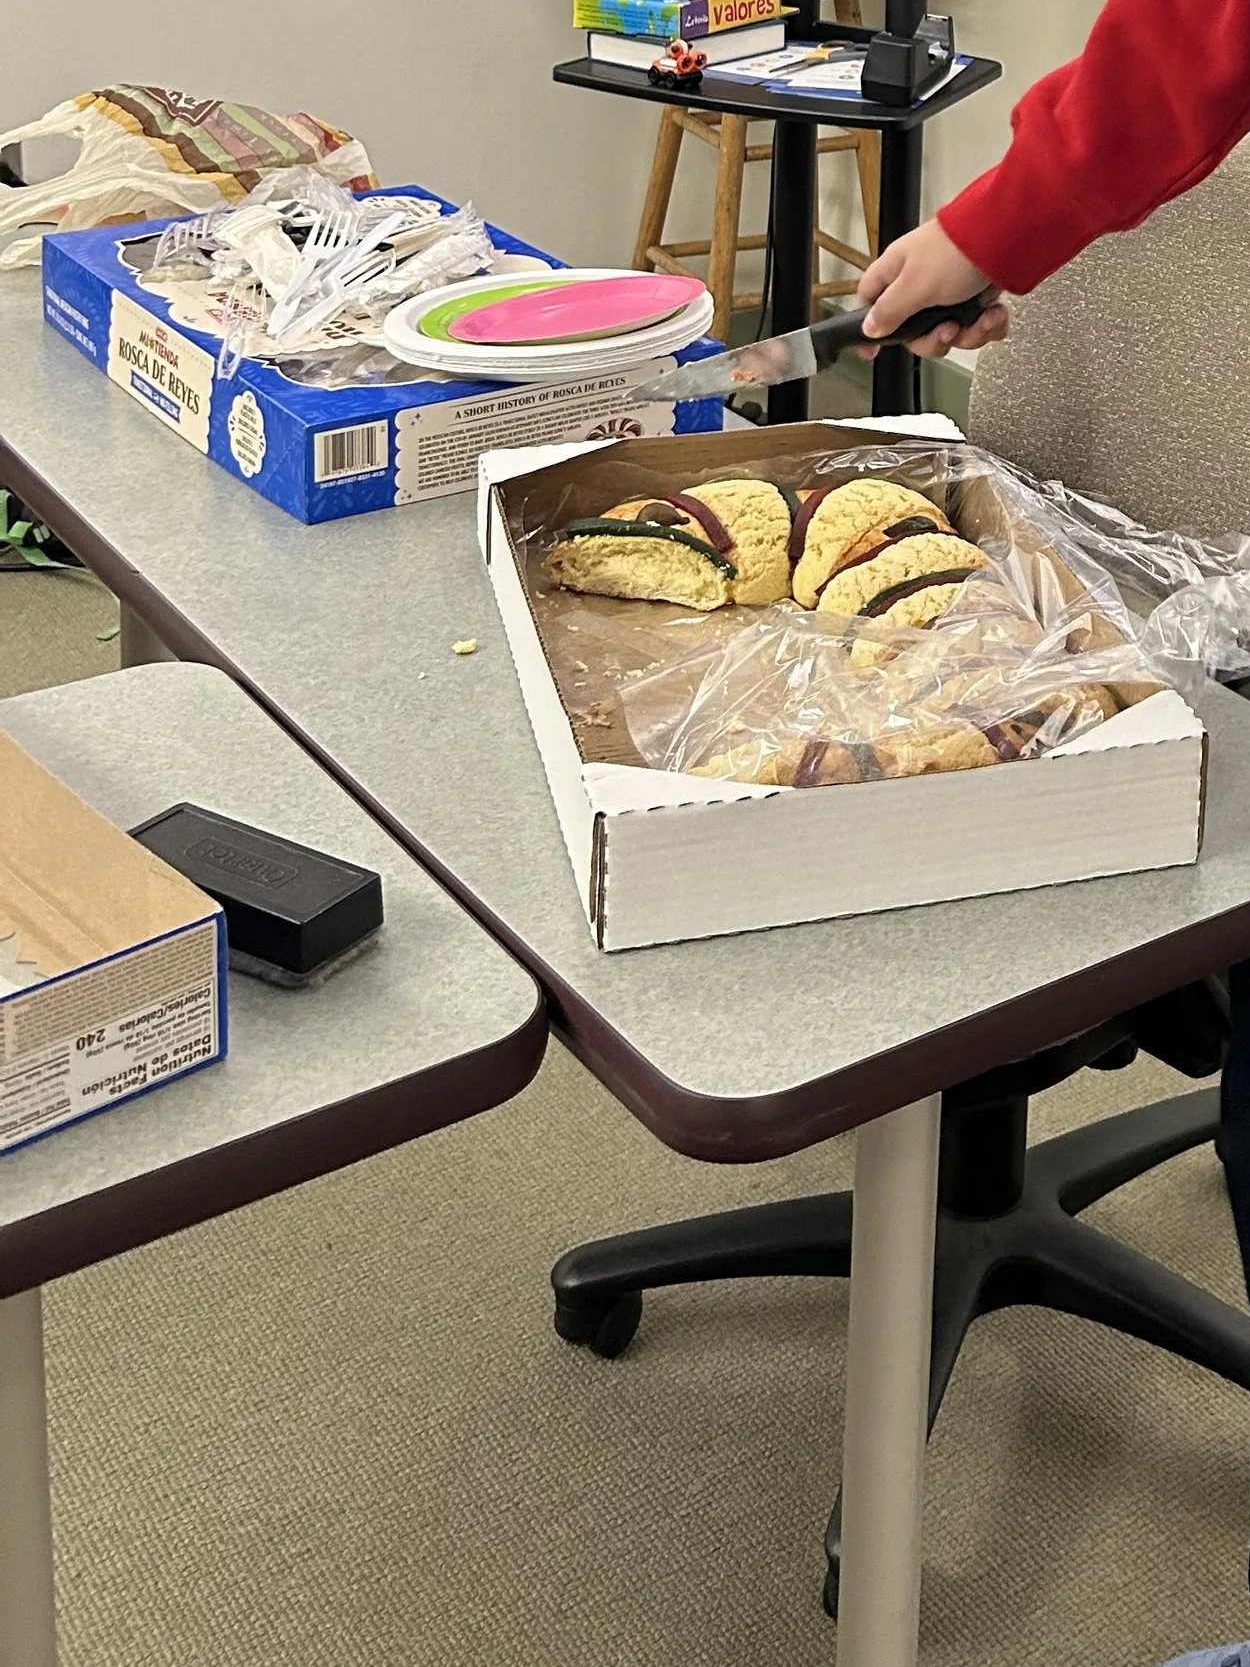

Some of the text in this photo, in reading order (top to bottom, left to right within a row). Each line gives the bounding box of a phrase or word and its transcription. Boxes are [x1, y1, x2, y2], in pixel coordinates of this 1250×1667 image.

[119, 337, 149, 374] ROSCA
[152, 358, 167, 386] DE
[168, 371, 200, 415] REYES
[154, 339, 179, 369] TIENDA
[454, 376, 627, 420] A SHORT HISTORY OF ROSCA DE REYES
[76, 987, 211, 1052] Calories/Calorias 240
[82, 1034, 212, 1097] Datos de Nutrición
[109, 1045, 212, 1096] Nutrition Facts
